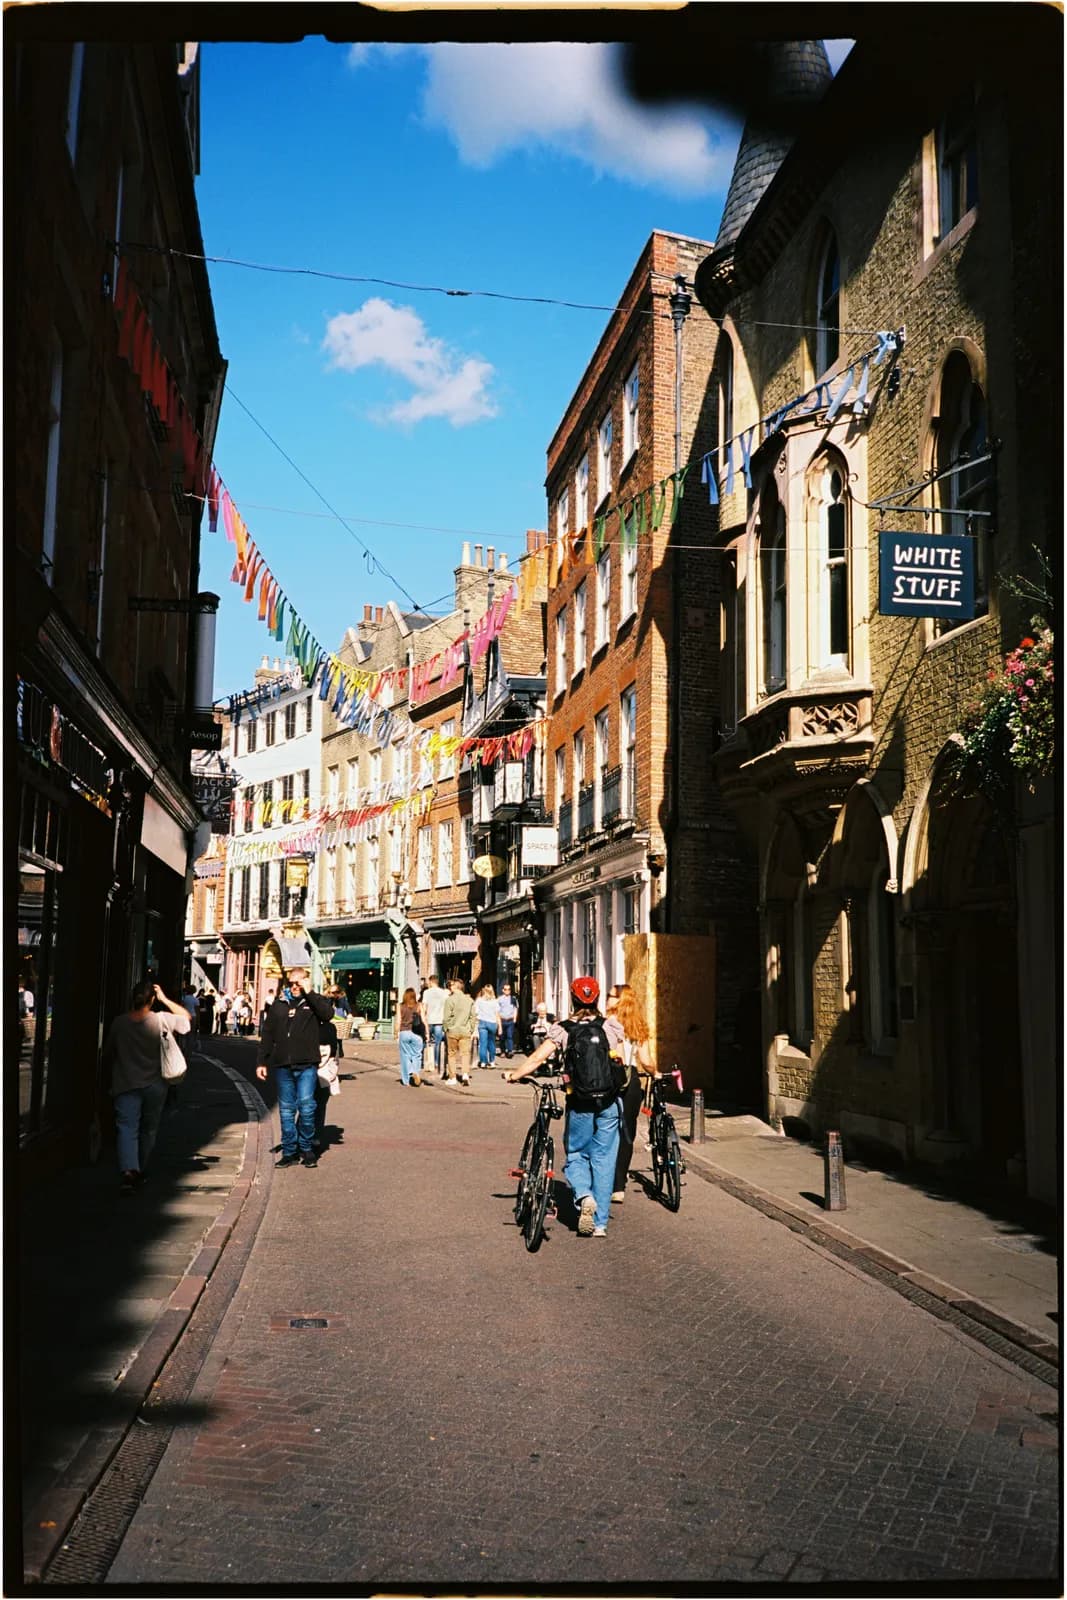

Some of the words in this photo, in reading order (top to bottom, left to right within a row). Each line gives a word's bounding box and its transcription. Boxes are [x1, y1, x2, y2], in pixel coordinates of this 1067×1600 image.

[895, 545, 962, 568] WHITE
[893, 576, 961, 598] STUFF
[190, 730, 218, 741] Aesop
[195, 778, 231, 788] JACKS
